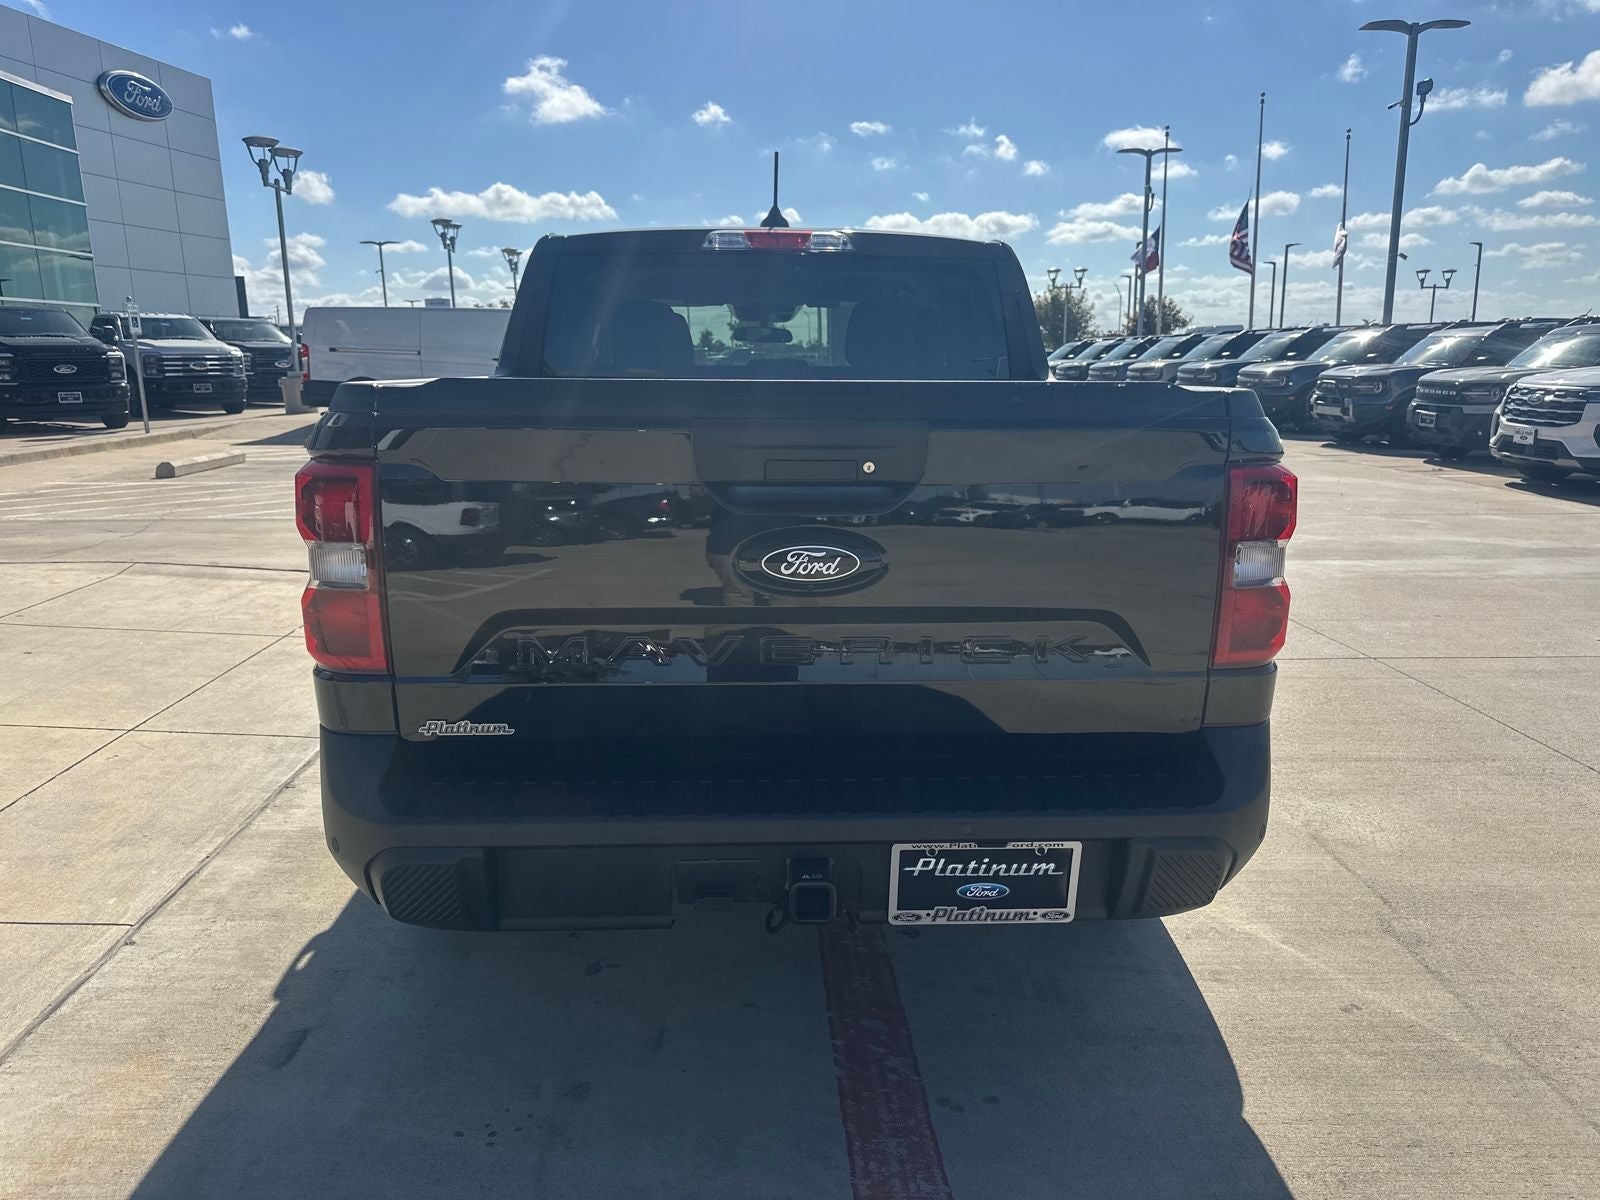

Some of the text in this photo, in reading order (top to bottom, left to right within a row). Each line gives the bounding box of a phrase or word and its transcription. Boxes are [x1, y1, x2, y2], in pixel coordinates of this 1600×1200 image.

[124, 80, 161, 112] Ford
[780, 550, 841, 575] Ford
[516, 635, 1089, 666] MAVERICK
[419, 720, 515, 736] Platinum
[903, 857, 1064, 877] Platinum
[966, 885, 1000, 898] Ford
[931, 906, 1038, 923] Platinum
